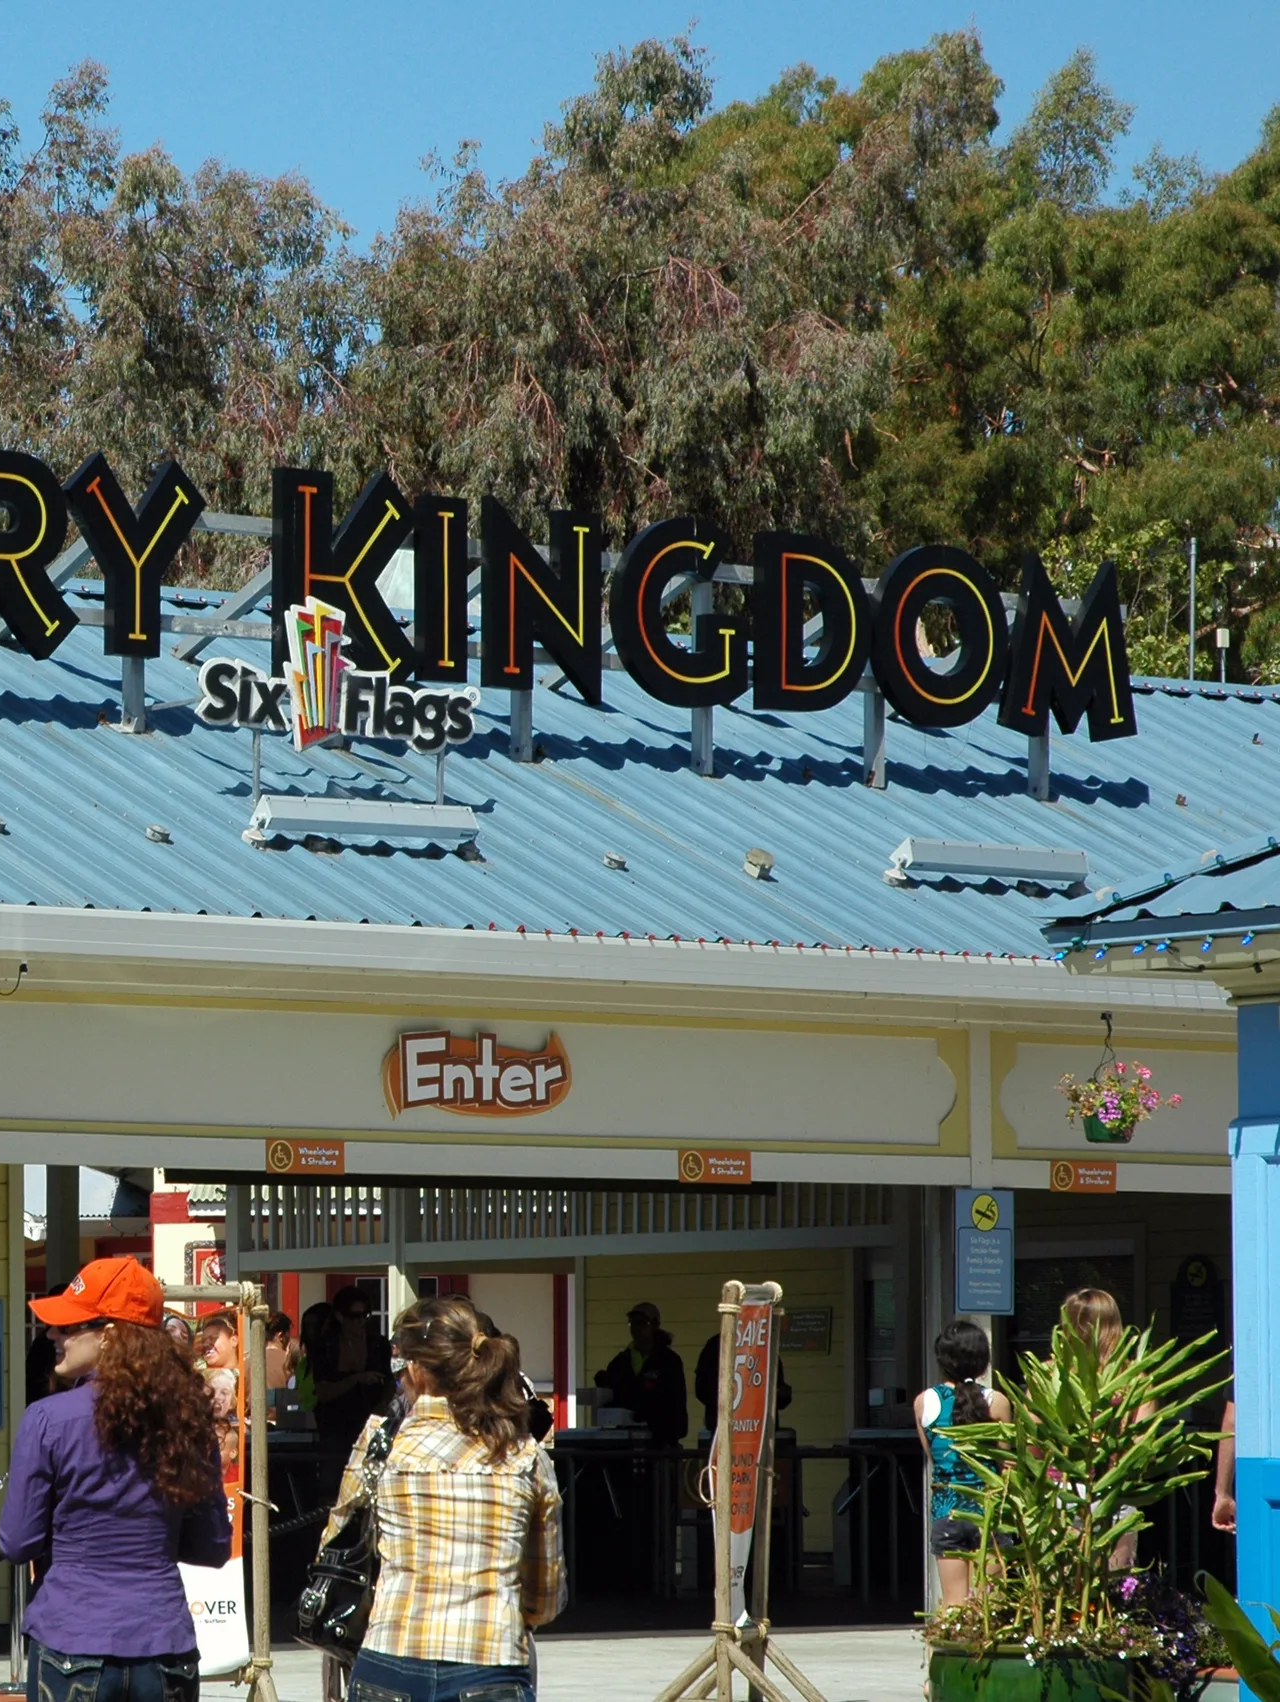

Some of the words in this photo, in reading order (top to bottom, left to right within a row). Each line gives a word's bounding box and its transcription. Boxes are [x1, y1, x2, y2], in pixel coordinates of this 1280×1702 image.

[272, 468, 1138, 743] KINGDOM
[197, 659, 292, 731] Six
[342, 671, 476, 752] Flags
[403, 1035, 565, 1105] Enter
[298, 1146, 340, 1156] Wheelchairs
[307, 1156, 337, 1166] Strollers
[736, 1319, 767, 1347] SAVE
